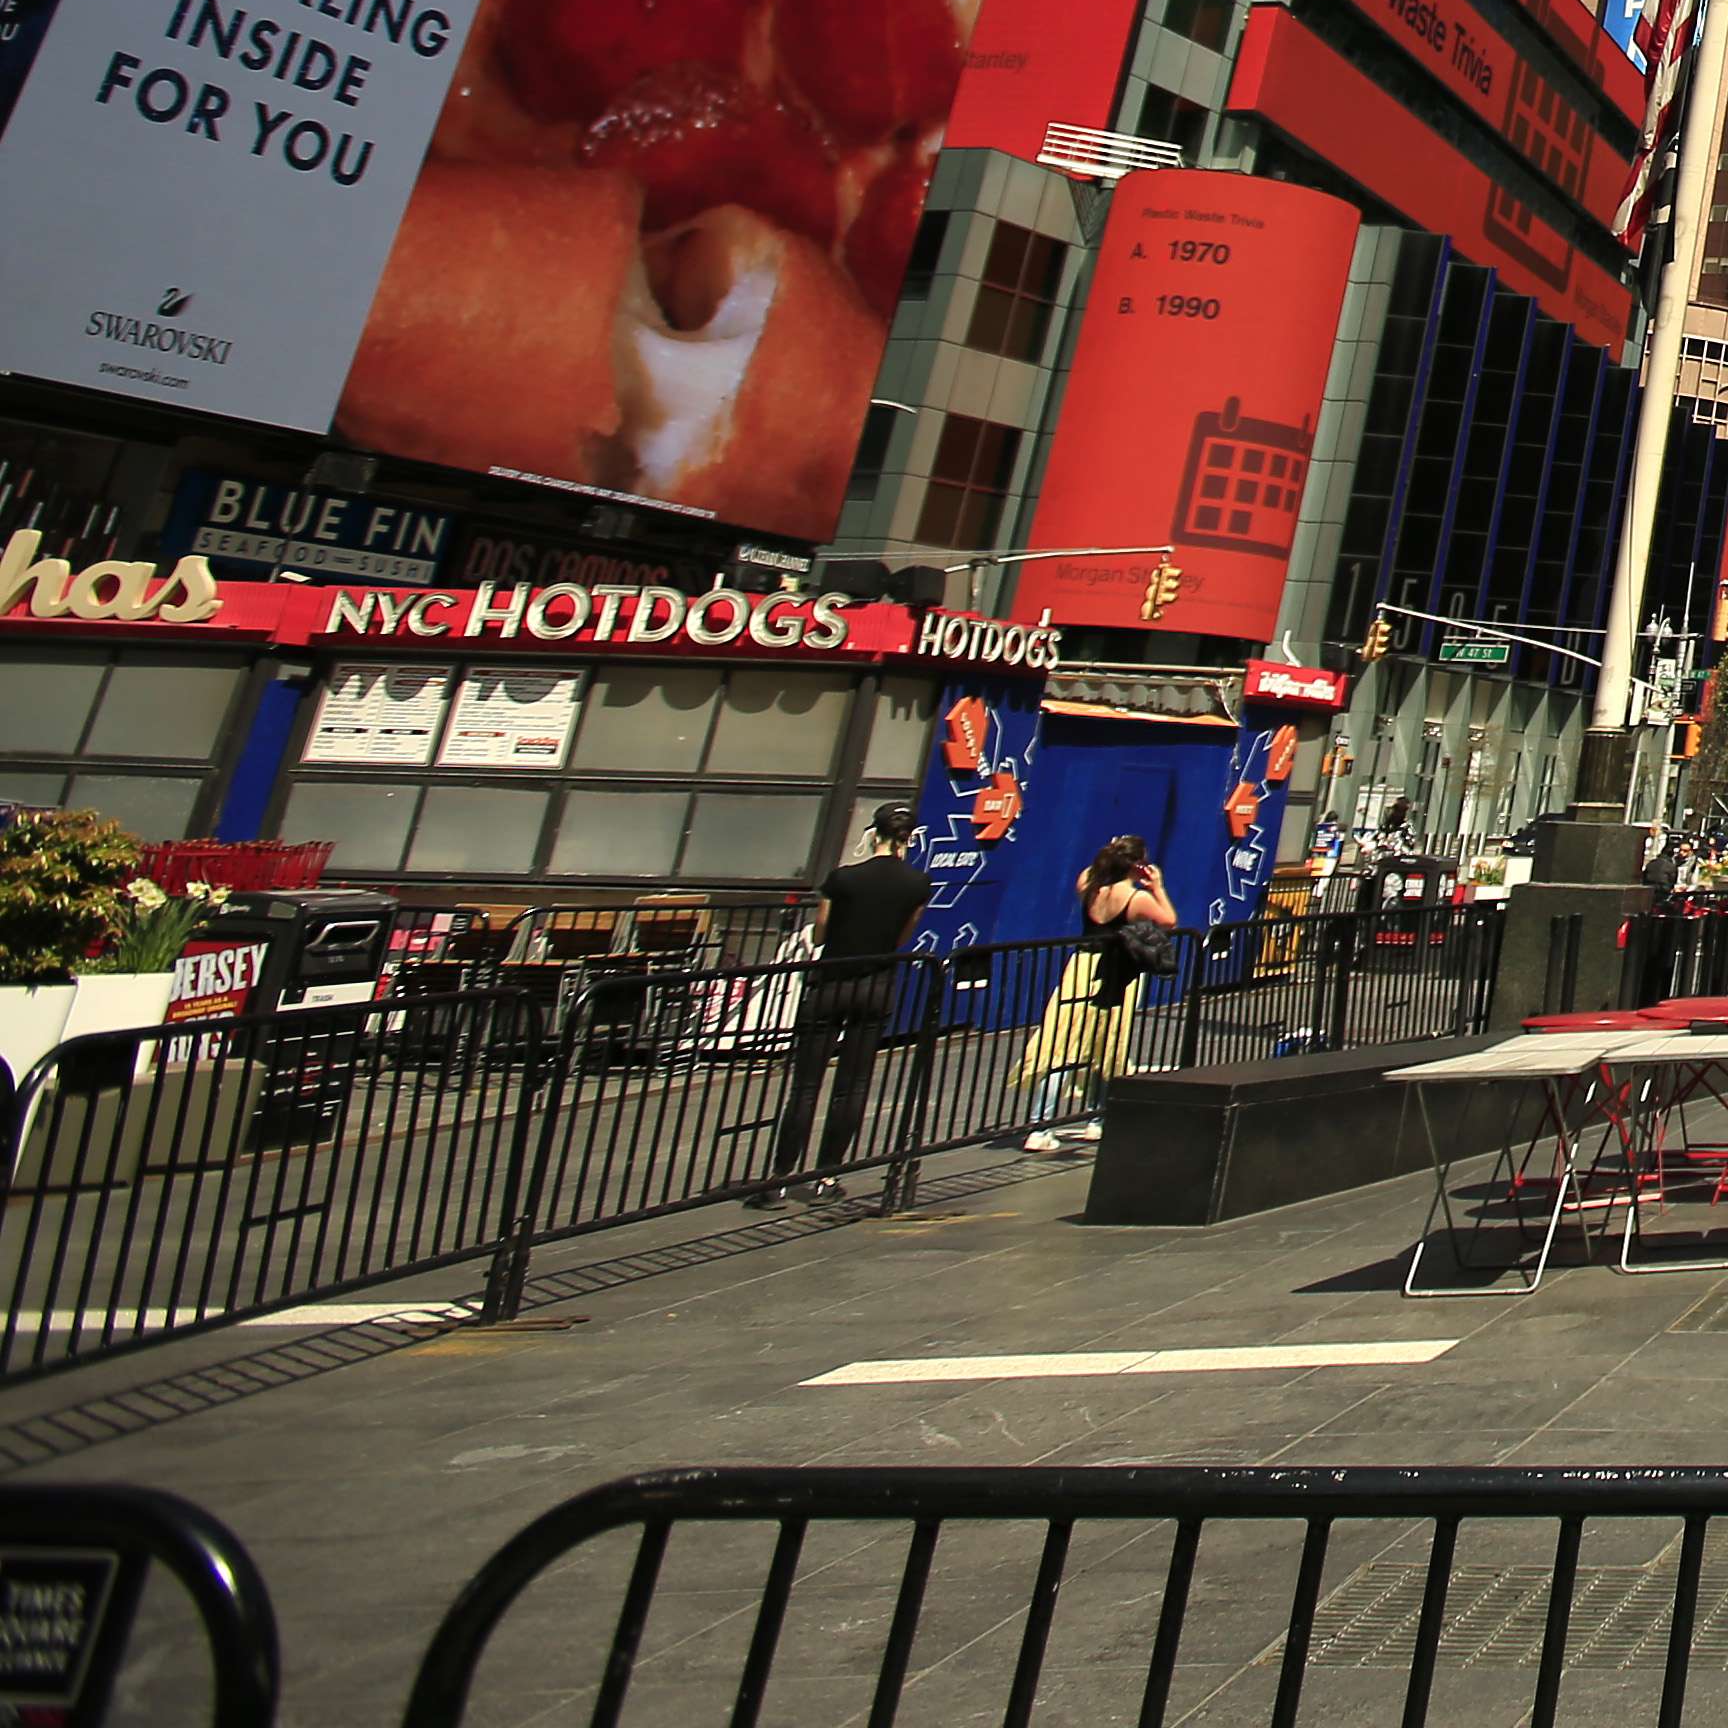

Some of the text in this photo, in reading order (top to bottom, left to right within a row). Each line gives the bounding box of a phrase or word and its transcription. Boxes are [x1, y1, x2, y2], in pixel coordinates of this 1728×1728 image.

[1450, 18, 1494, 99] Trivia
[95, 52, 376, 187] FOR YOU
[1141, 208, 1265, 231] Plastic Waste Trivia
[1130, 240, 1232, 266] A. 1970
[1117, 294, 1221, 321] B. 1990
[85, 311, 233, 365] SWAROVSKI
[98, 360, 190, 391] swarovski.com
[209, 480, 446, 556] BLUE FIN
[1055, 563, 1123, 590] Morgan
[324, 580, 853, 650] NYC HOTDOGS
[918, 612, 1063, 670] HOTDOGS
[1467, 648, 1493, 660] 47 St
[170, 941, 269, 1003] JERSEY
